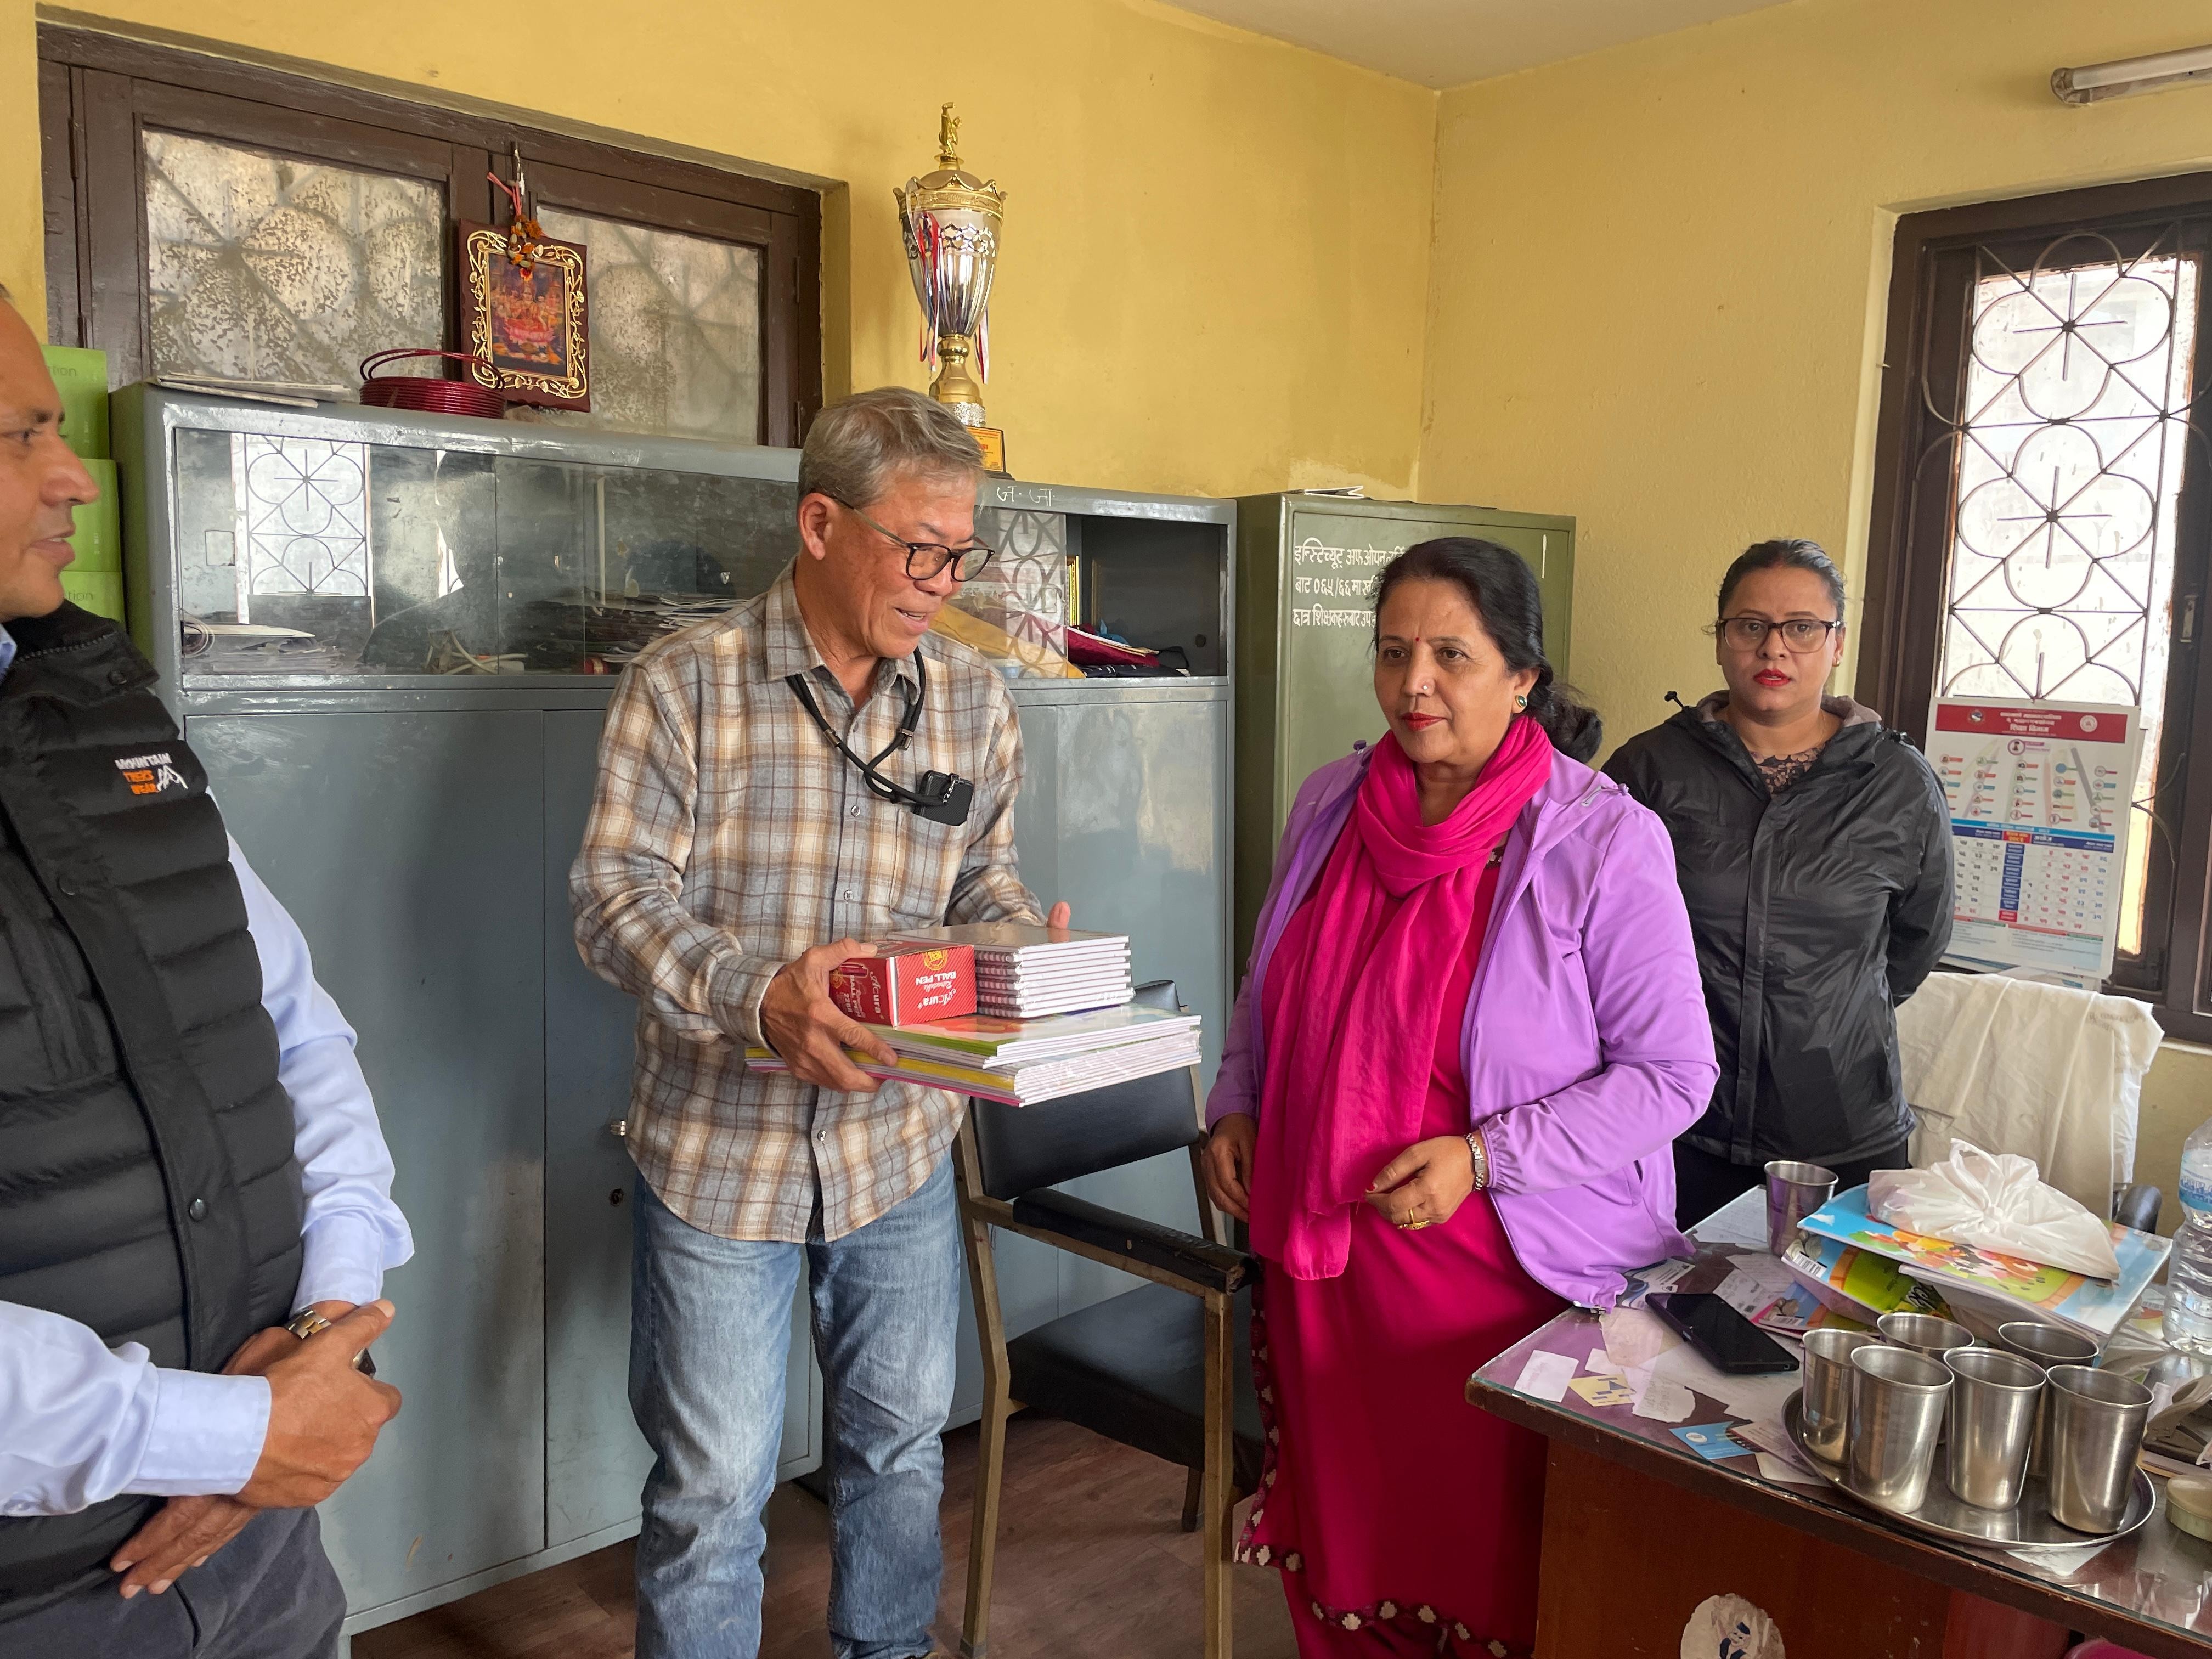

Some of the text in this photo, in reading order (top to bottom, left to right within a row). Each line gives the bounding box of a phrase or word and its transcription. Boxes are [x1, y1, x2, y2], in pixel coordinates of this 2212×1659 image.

[1346, 549, 1363, 565] अफ
[1295, 577, 1312, 593] बाट
[67, 590, 94, 601] tion
[115, 753, 173, 770] MOUNTAIN
[915, 971, 957, 985] BALL PEN
